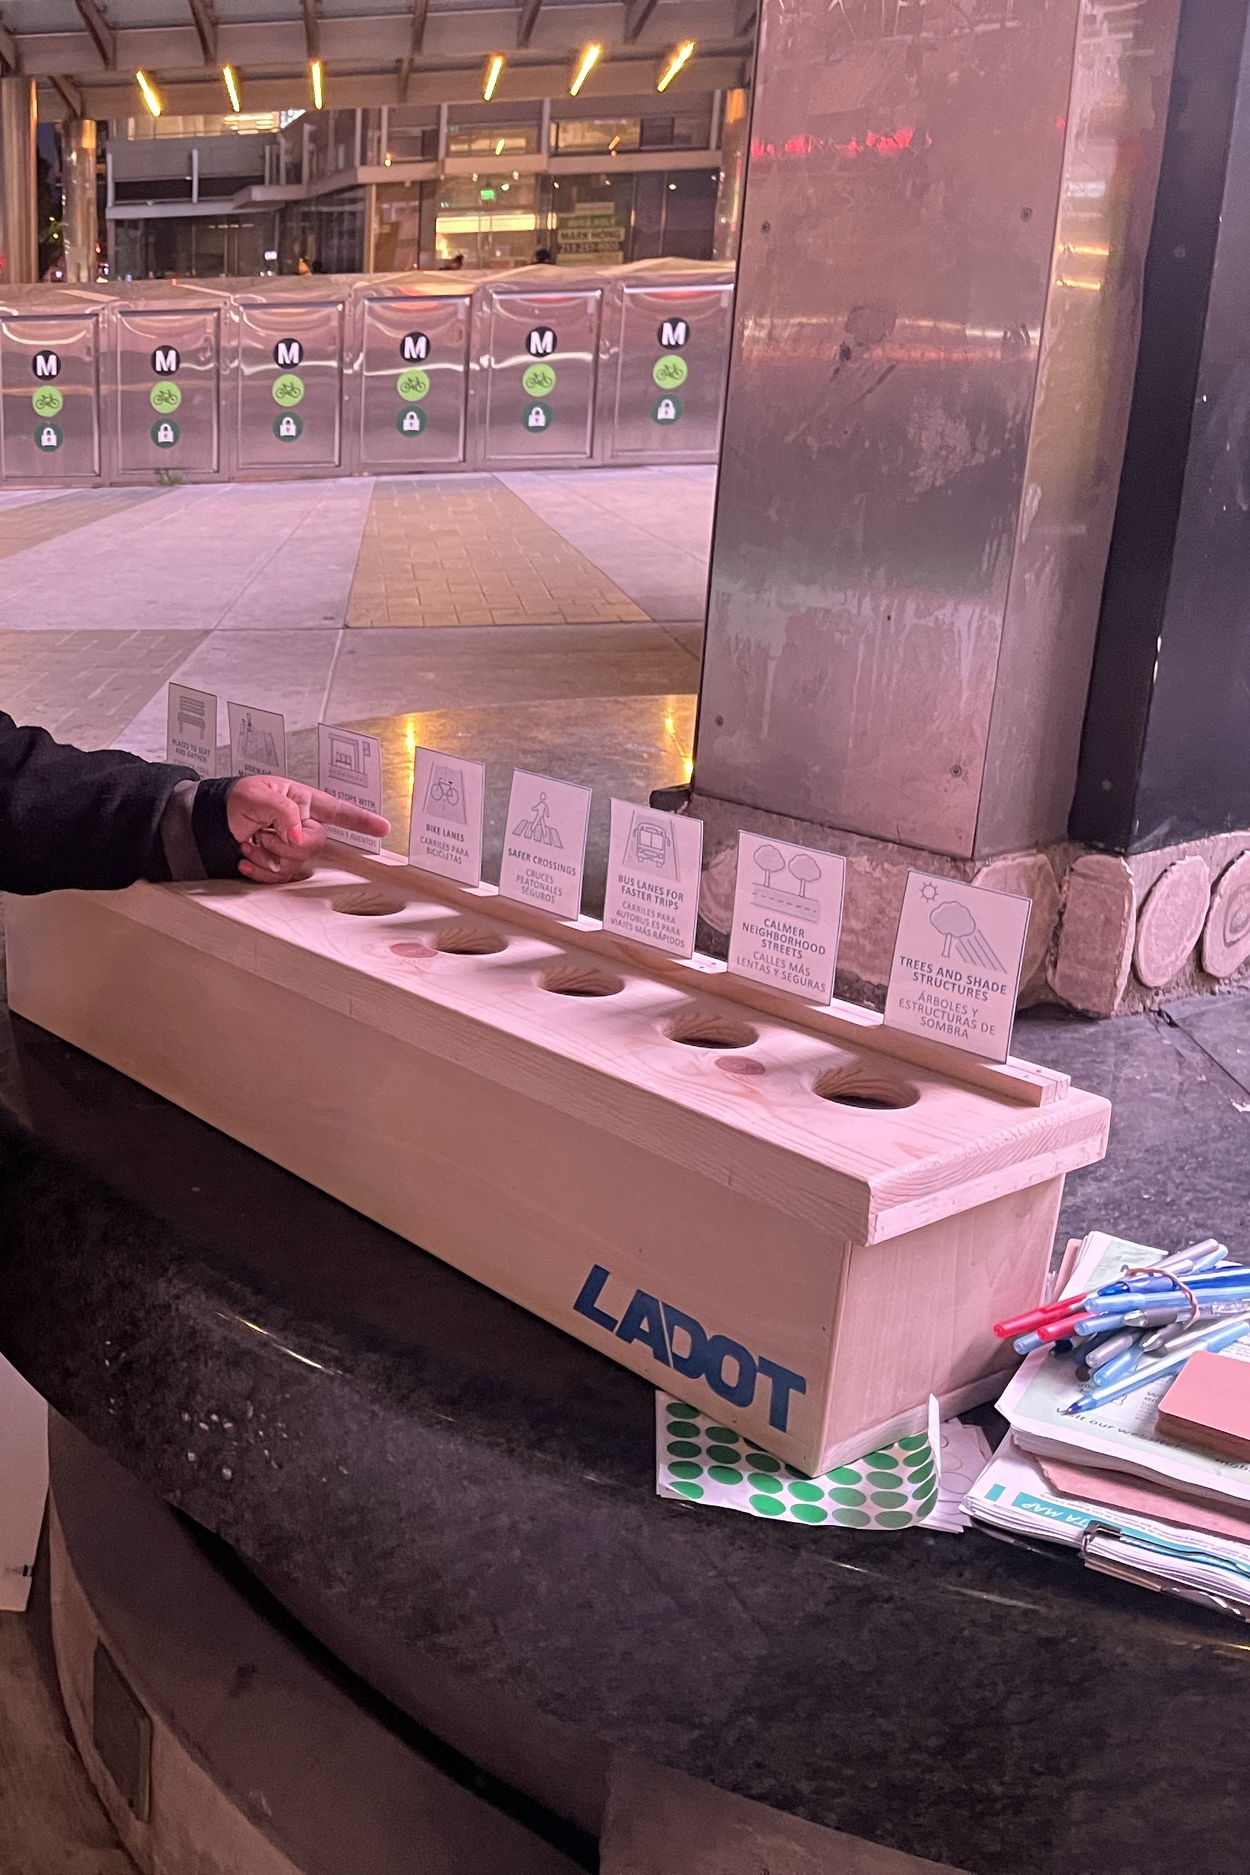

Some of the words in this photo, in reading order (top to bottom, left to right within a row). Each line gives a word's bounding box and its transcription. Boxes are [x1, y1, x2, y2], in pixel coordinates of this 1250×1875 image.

[530, 330, 554, 354] M
[661, 321, 686, 346] M
[277, 342, 300, 365] M
[404, 336, 427, 359] M
[36, 354, 57, 376] M
[155, 349, 177, 372] M
[172, 738, 190, 750] PLACES
[338, 791, 357, 804] STOPS
[358, 797, 376, 809] WITH
[426, 823, 441, 835] BIKE
[442, 829, 464, 842] LANES
[420, 836, 450, 851] CARRILES
[451, 845, 469, 858] PARA
[426, 846, 462, 865] BICICLETAS
[508, 848, 531, 862] SAFER
[532, 856, 576, 876] CROSSINGS
[516, 874, 563, 897] PEATONALES
[525, 868, 554, 884] CRUCES
[521, 886, 556, 904] SEGUROS
[618, 874, 635, 887] BUS
[636, 880, 664, 896] LANES
[666, 889, 684, 902] FOR
[621, 885, 652, 902] FASTER
[654, 895, 679, 911] TRIPS
[621, 900, 655, 918] CARRILES
[656, 911, 676, 925] PARA
[610, 917, 633, 932] VIAJES
[634, 924, 652, 937] MÁS
[652, 930, 685, 948] RÁPIDOS
[661, 923, 681, 937] PARA
[742, 922, 826, 955] NEIGHBORHOOD
[763, 918, 805, 938] CALMER
[761, 938, 803, 960] STREETS
[737, 956, 771, 975] LENTAS
[773, 967, 780, 977] Y
[781, 970, 826, 993] SEGURAS
[753, 951, 786, 969] CALLES
[789, 962, 811, 977] MÁS
[900, 955, 934, 974] TREES
[936, 966, 963, 982] AND
[966, 974, 1008, 996] SHADE
[912, 971, 989, 1002] STRUCTURES
[917, 990, 968, 1016] ÁRBOLES
[971, 1006, 979, 1018] Y
[899, 997, 978, 1030] ESTRUCTURAS
[980, 1022, 997, 1036] DE
[919, 1015, 970, 1040] SOMBRA
[573, 1263, 807, 1434] LADOT
[1089, 1420, 1115, 1430] our
[1021, 1502, 1064, 1518] MAP
